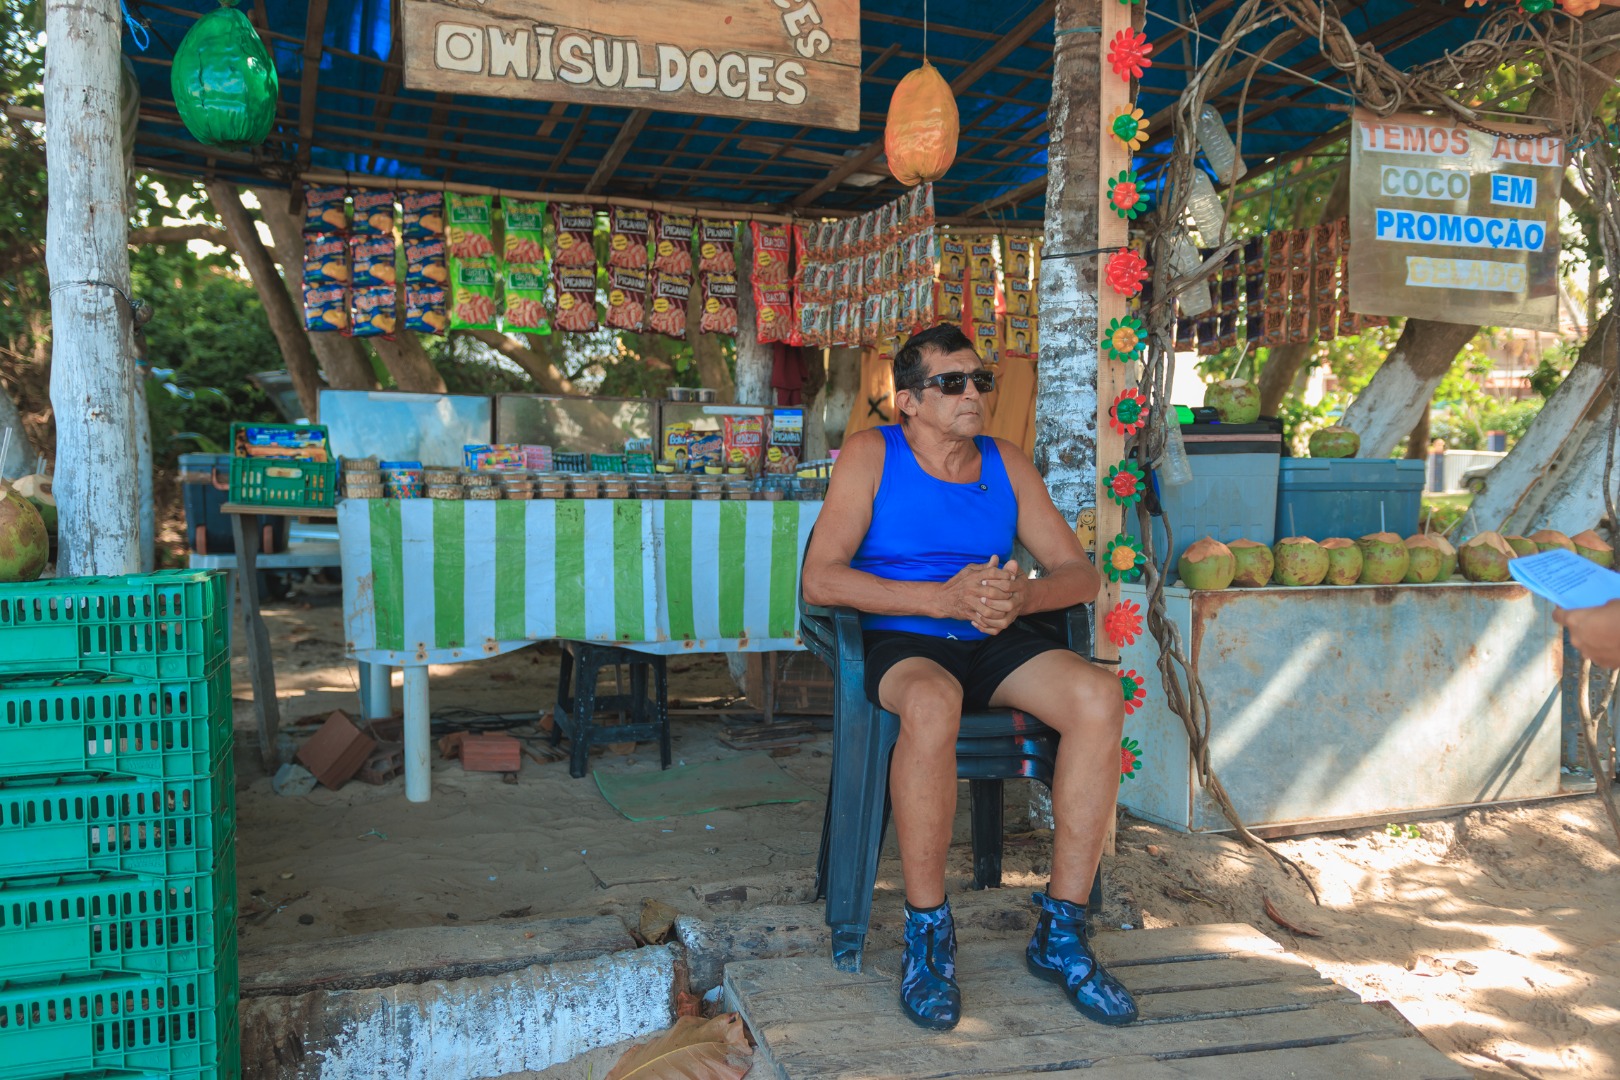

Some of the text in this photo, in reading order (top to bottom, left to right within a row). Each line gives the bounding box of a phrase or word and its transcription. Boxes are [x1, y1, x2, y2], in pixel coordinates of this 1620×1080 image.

[1361, 123, 1563, 165] TEMOS AQUI
[1382, 167, 1533, 205] COCO EM
[1376, 209, 1544, 249] PROMOÇÃO
[1408, 257, 1525, 291] GELADO
